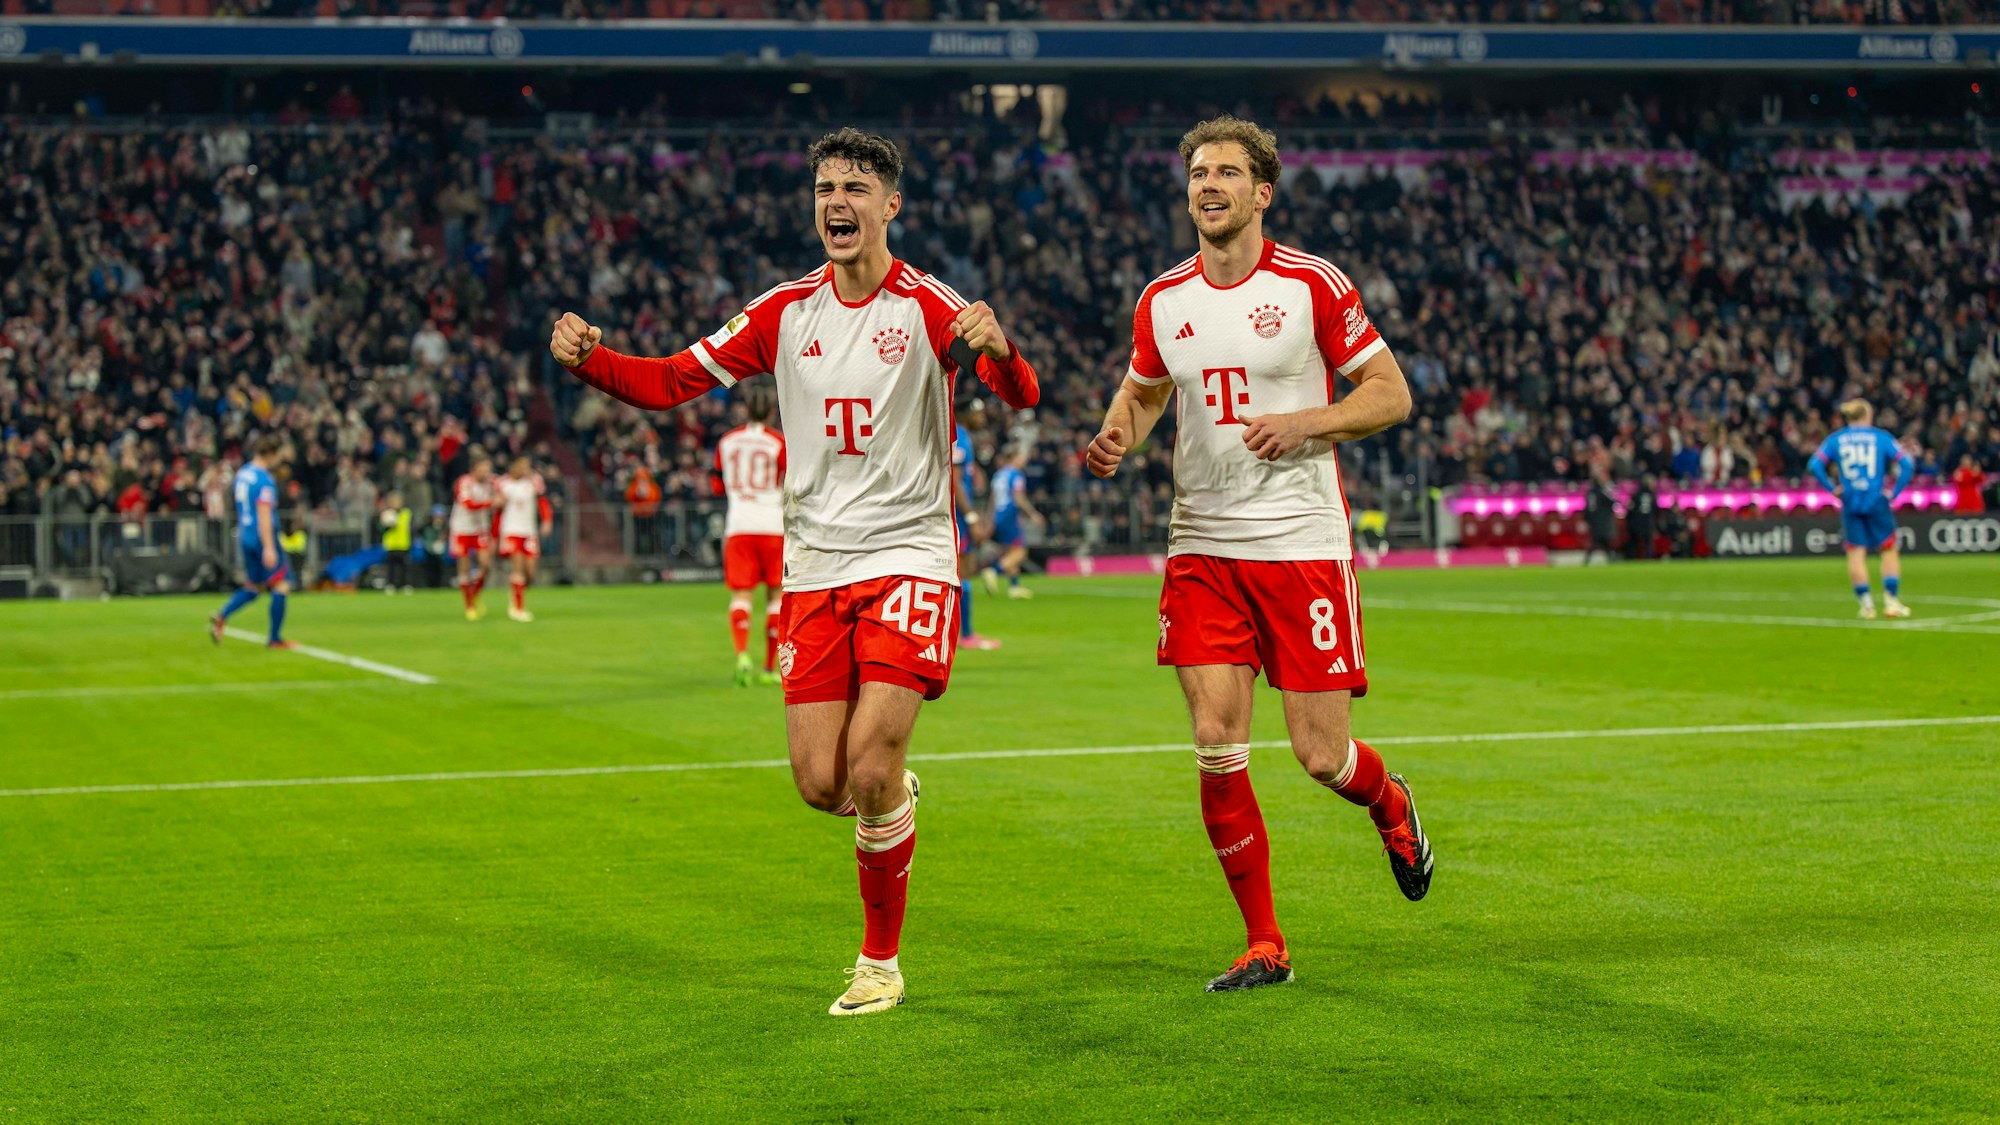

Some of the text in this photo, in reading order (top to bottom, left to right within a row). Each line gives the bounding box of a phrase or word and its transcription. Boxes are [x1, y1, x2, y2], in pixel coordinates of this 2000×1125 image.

[409, 30, 488, 54] Allianz
[929, 32, 1004, 55] Allianz
[1858, 36, 1927, 58] Allianz
[825, 398, 872, 455] T
[730, 449, 770, 490] 10
[1840, 443, 1877, 480] 24
[1717, 526, 1793, 554] Audi
[881, 580, 942, 637] 45
[1309, 598, 1337, 650] 8
